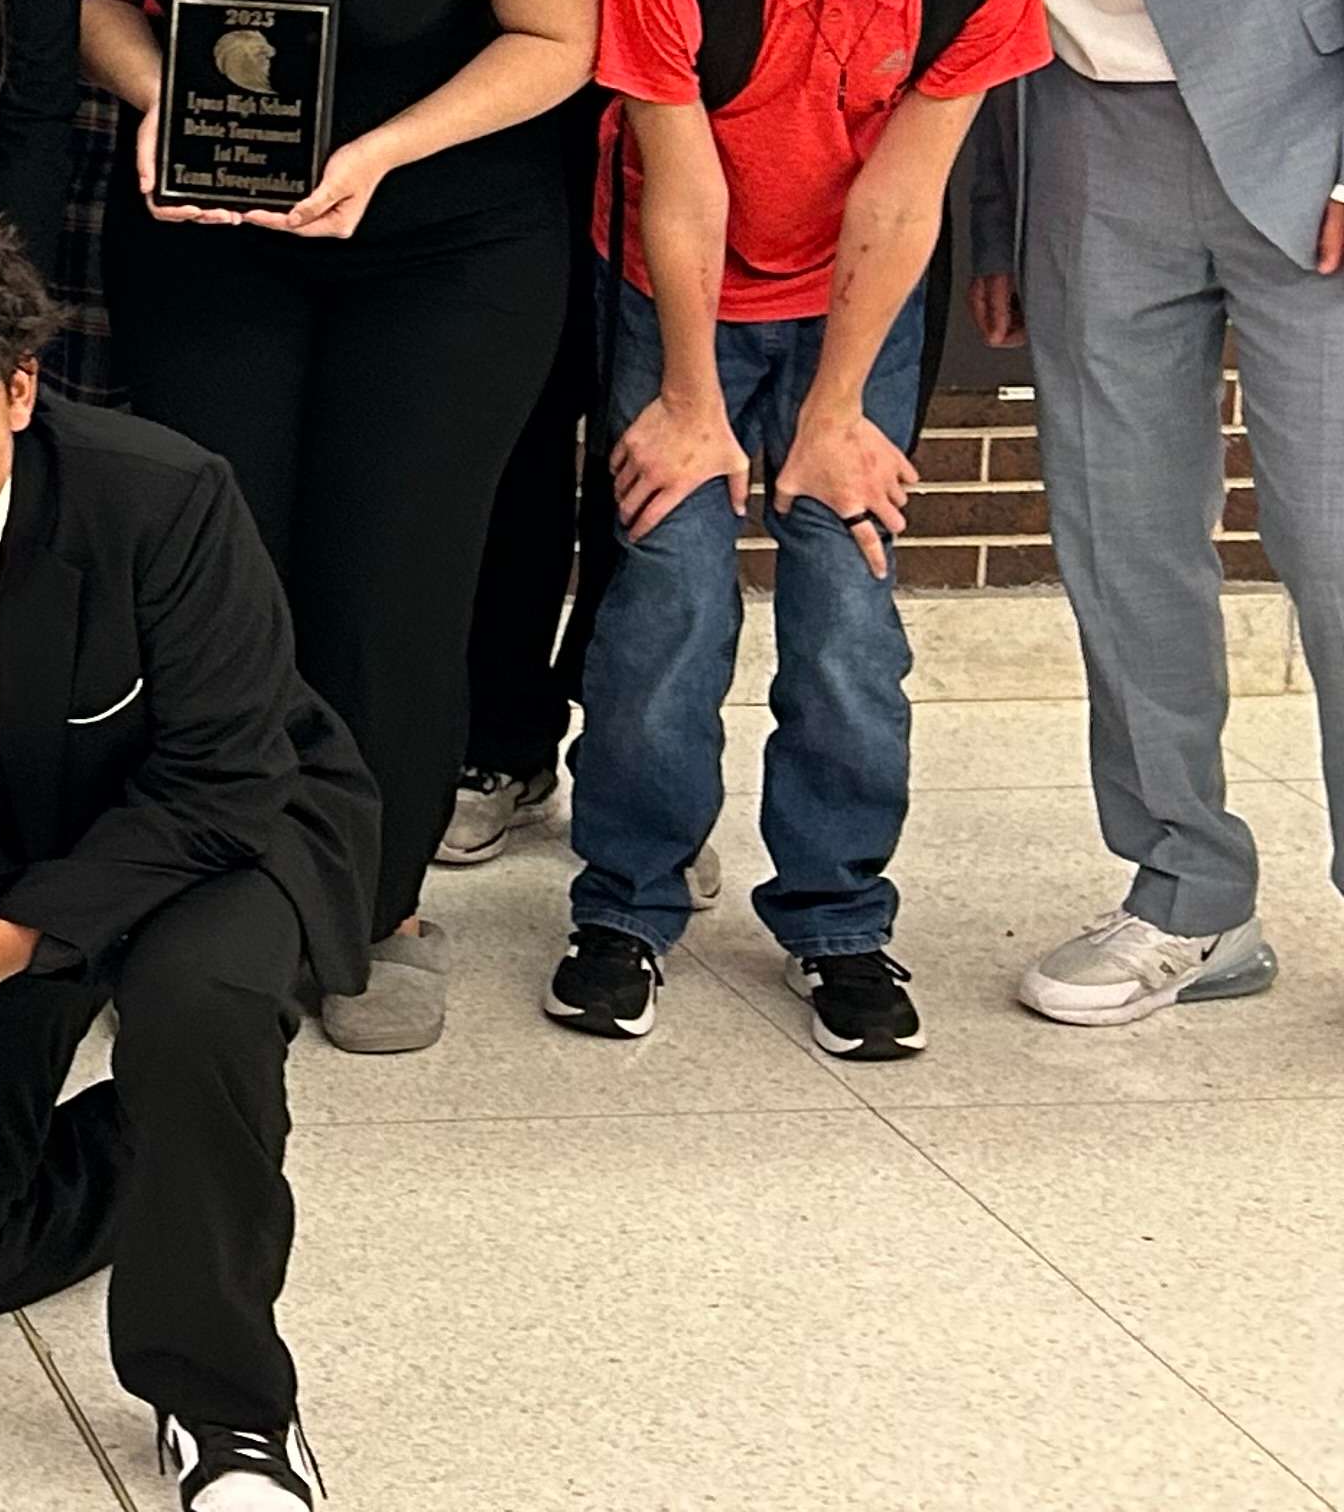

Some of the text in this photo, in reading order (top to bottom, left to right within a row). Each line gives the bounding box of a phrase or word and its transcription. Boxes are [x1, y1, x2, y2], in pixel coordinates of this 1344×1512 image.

[223, 8, 276, 28] 2025
[259, 96, 302, 117] School
[173, 163, 213, 186] Team
